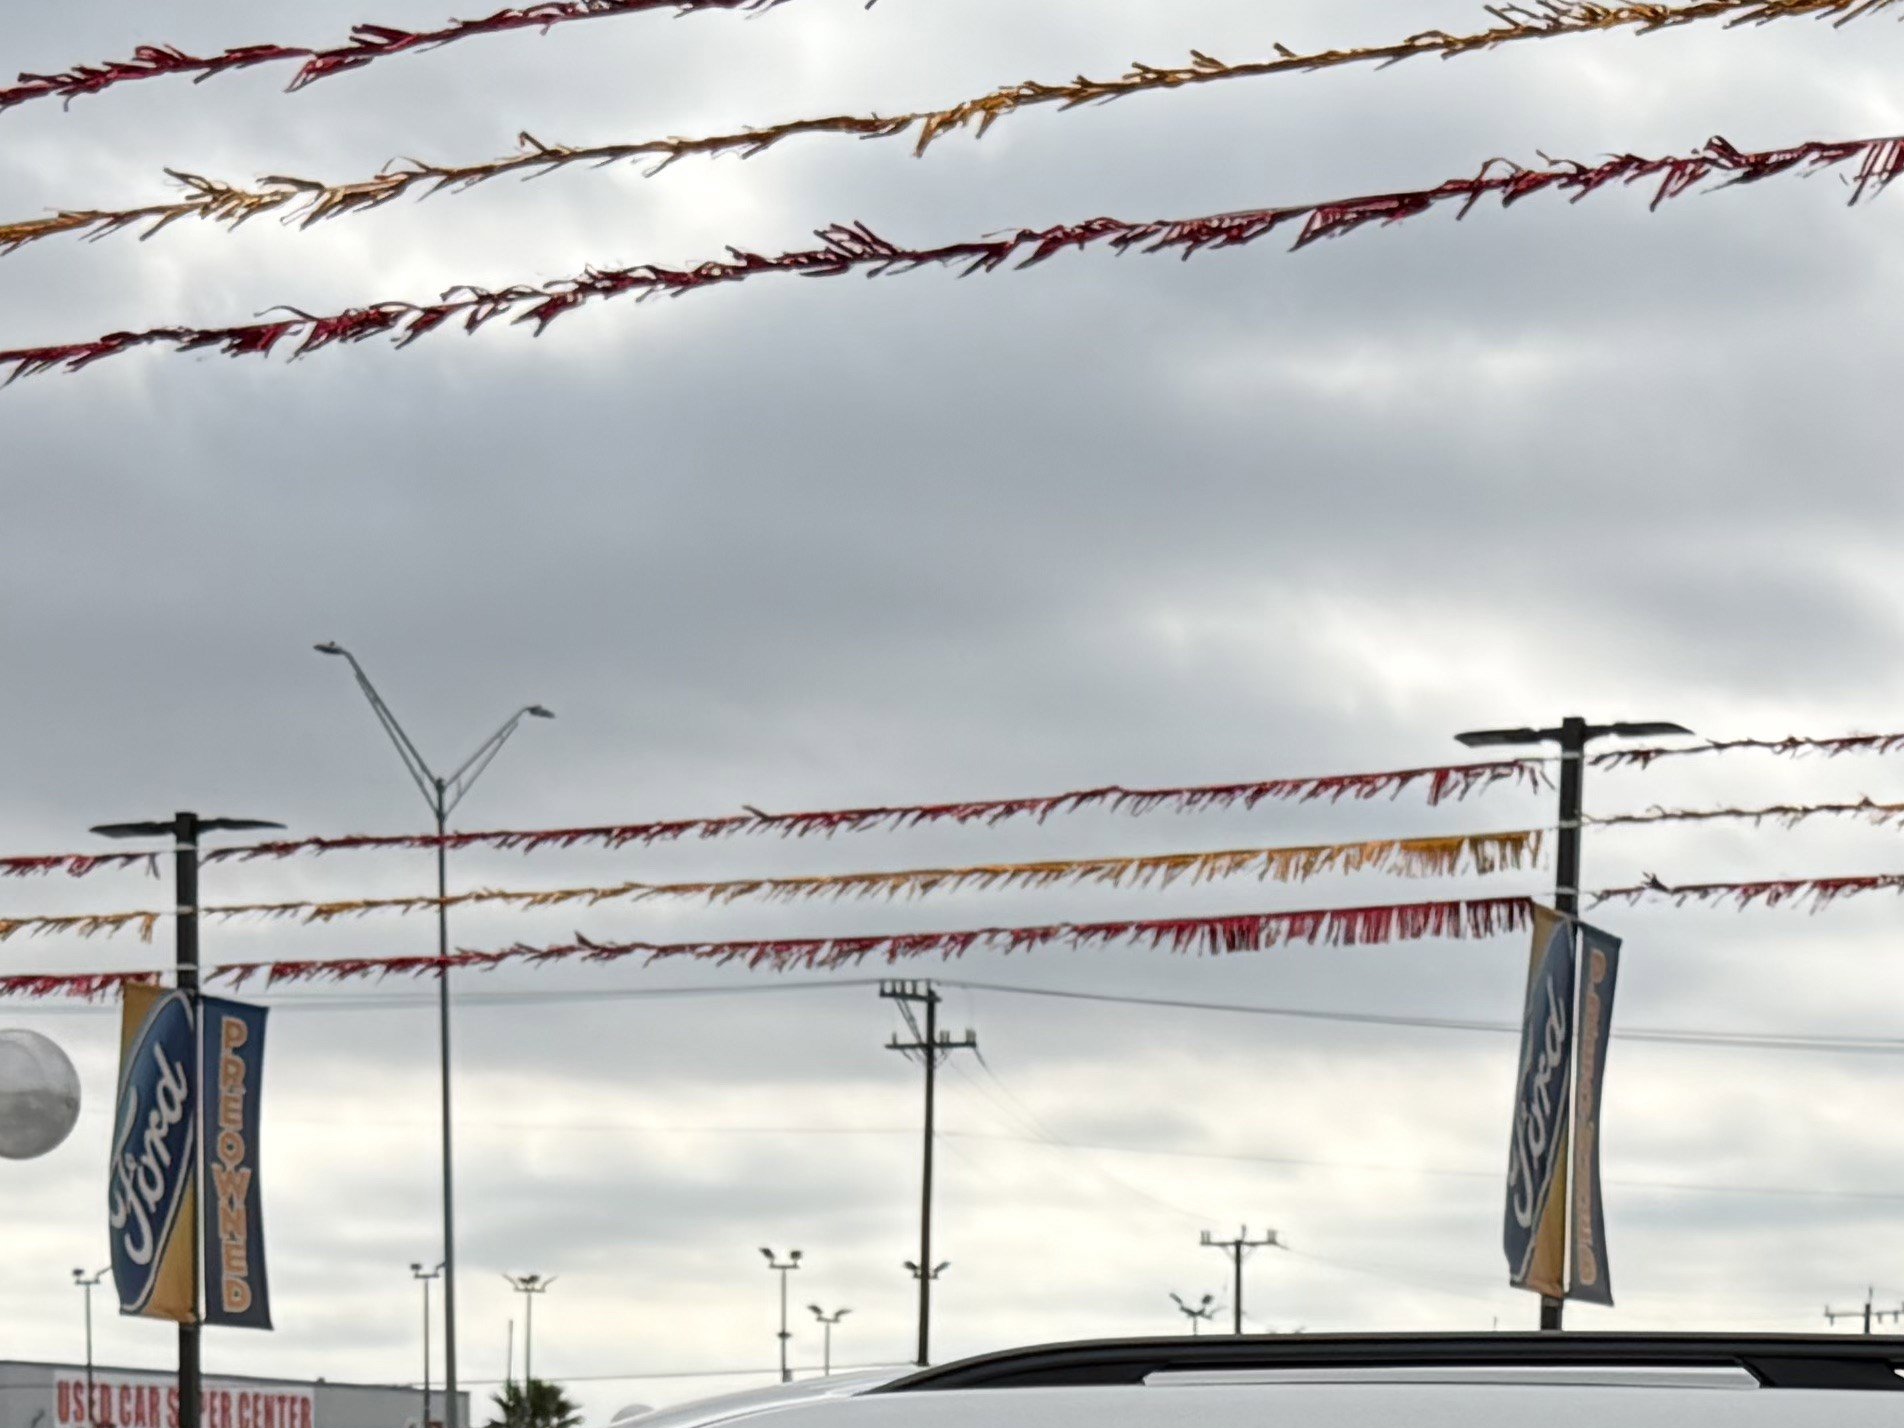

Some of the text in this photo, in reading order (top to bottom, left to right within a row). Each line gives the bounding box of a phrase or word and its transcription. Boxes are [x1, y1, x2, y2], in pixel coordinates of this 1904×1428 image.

[109, 1043, 187, 1265] Ford
[211, 1015, 253, 1313] PREOWNED
[1510, 975, 1567, 1228] Ford
[119, 1383, 161, 1428] CAR
